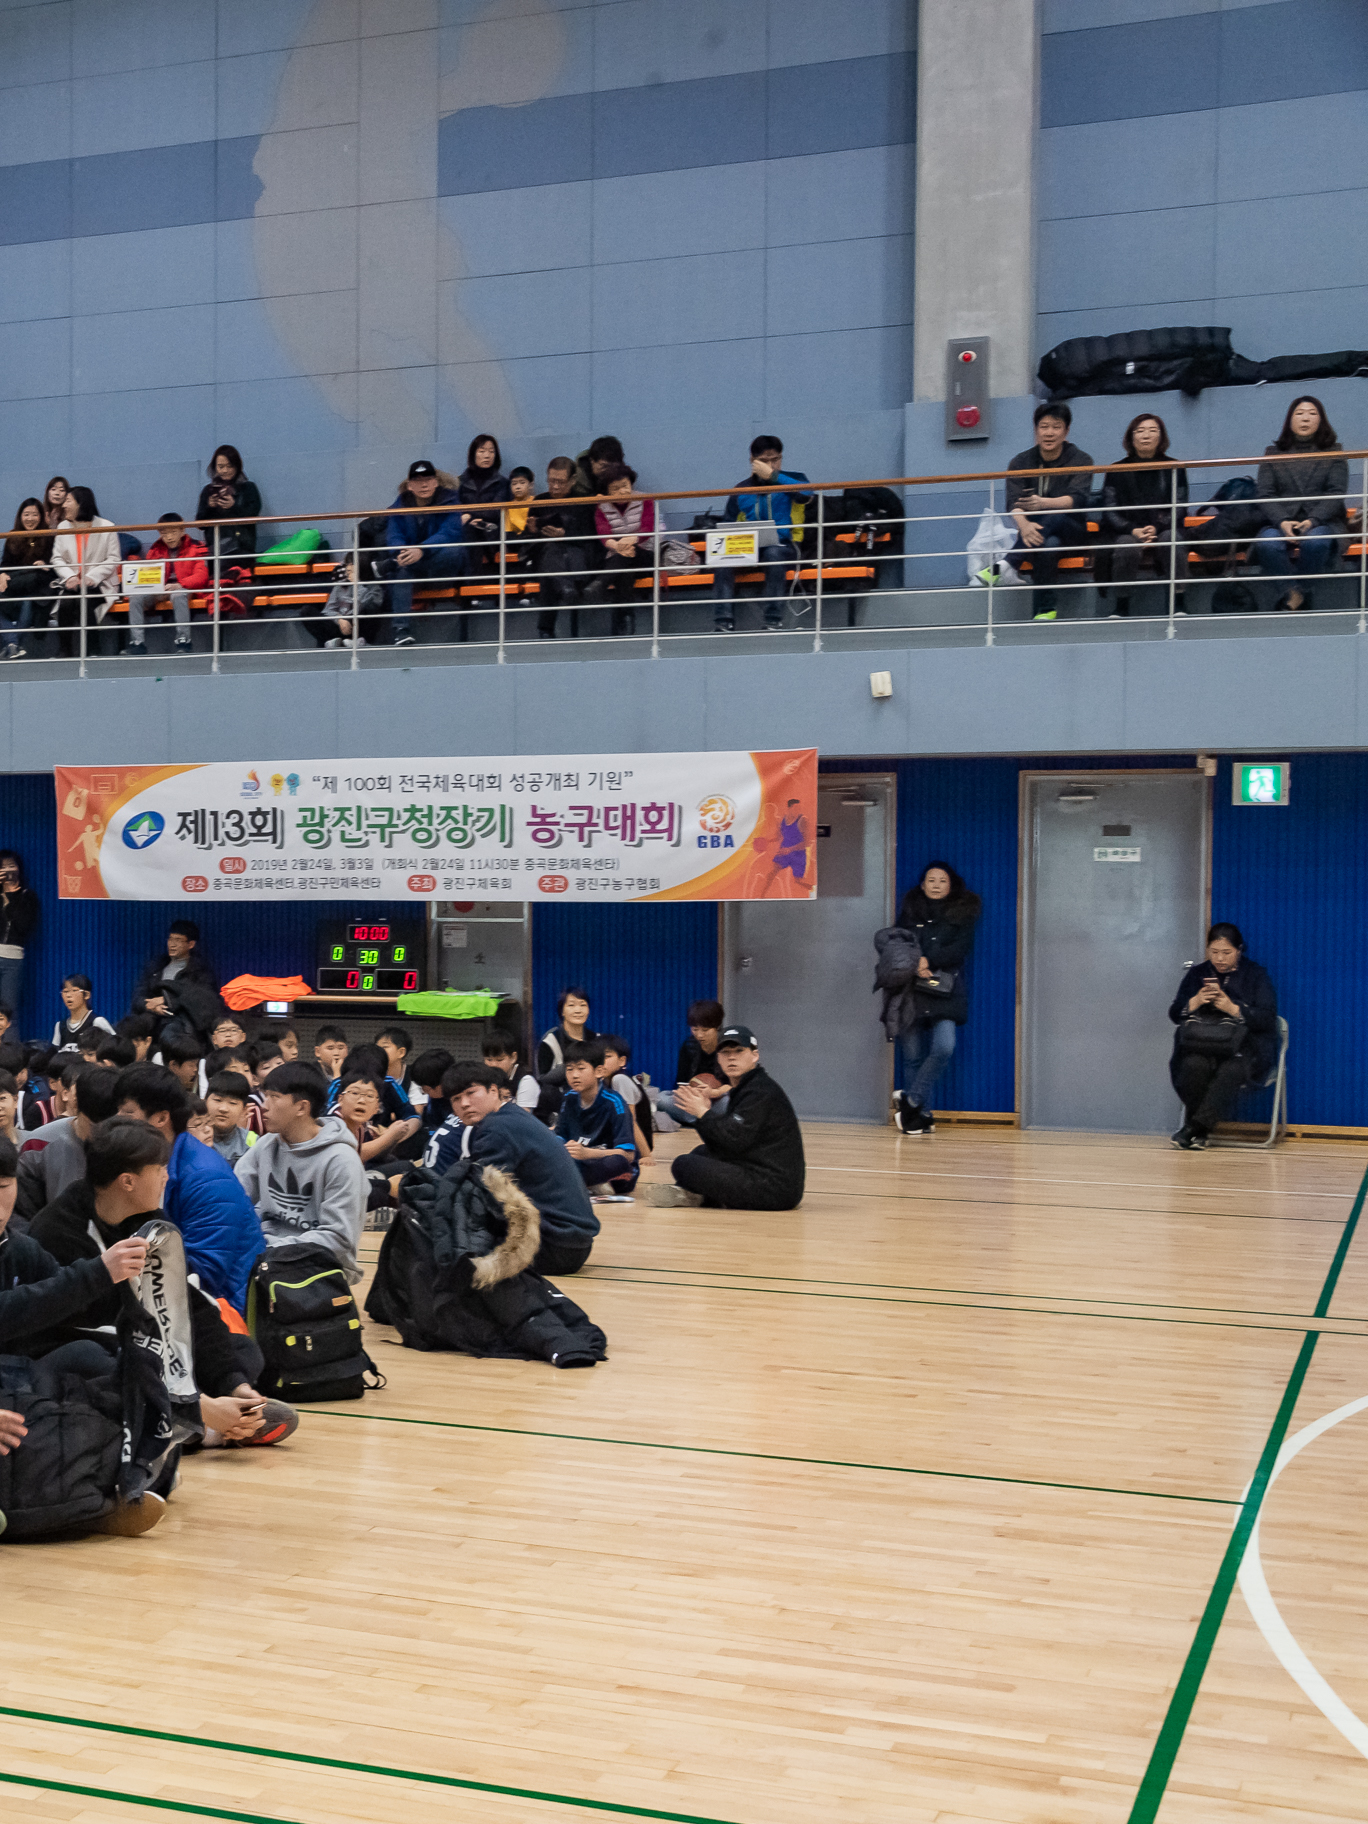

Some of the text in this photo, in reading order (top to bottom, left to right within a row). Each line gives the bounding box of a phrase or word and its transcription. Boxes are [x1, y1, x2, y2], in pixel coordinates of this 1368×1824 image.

[343, 775, 393, 793] 100회
[398, 773, 503, 793] 전국체육대회
[508, 771, 581, 793] 성공개최
[174, 801, 678, 847] 제13회 광진구청장기 농구대회
[697, 834, 735, 849] GBA
[221, 858, 245, 872] 일시
[250, 858, 288, 871] 2019년
[340, 857, 374, 871] 3월3일
[381, 857, 419, 871] (개회식
[421, 857, 465, 871] 2월24일
[469, 857, 520, 871] 11시30분
[183, 877, 208, 891] 장소
[409, 876, 513, 891] 주최 광진구체육회
[540, 876, 662, 891] 주관 광진구농구협회
[332, 946, 344, 961] 0
[358, 950, 379, 965] 30
[393, 947, 405, 962] 0
[345, 970, 360, 989] 0
[362, 975, 374, 990] 0
[403, 971, 417, 990] 0
